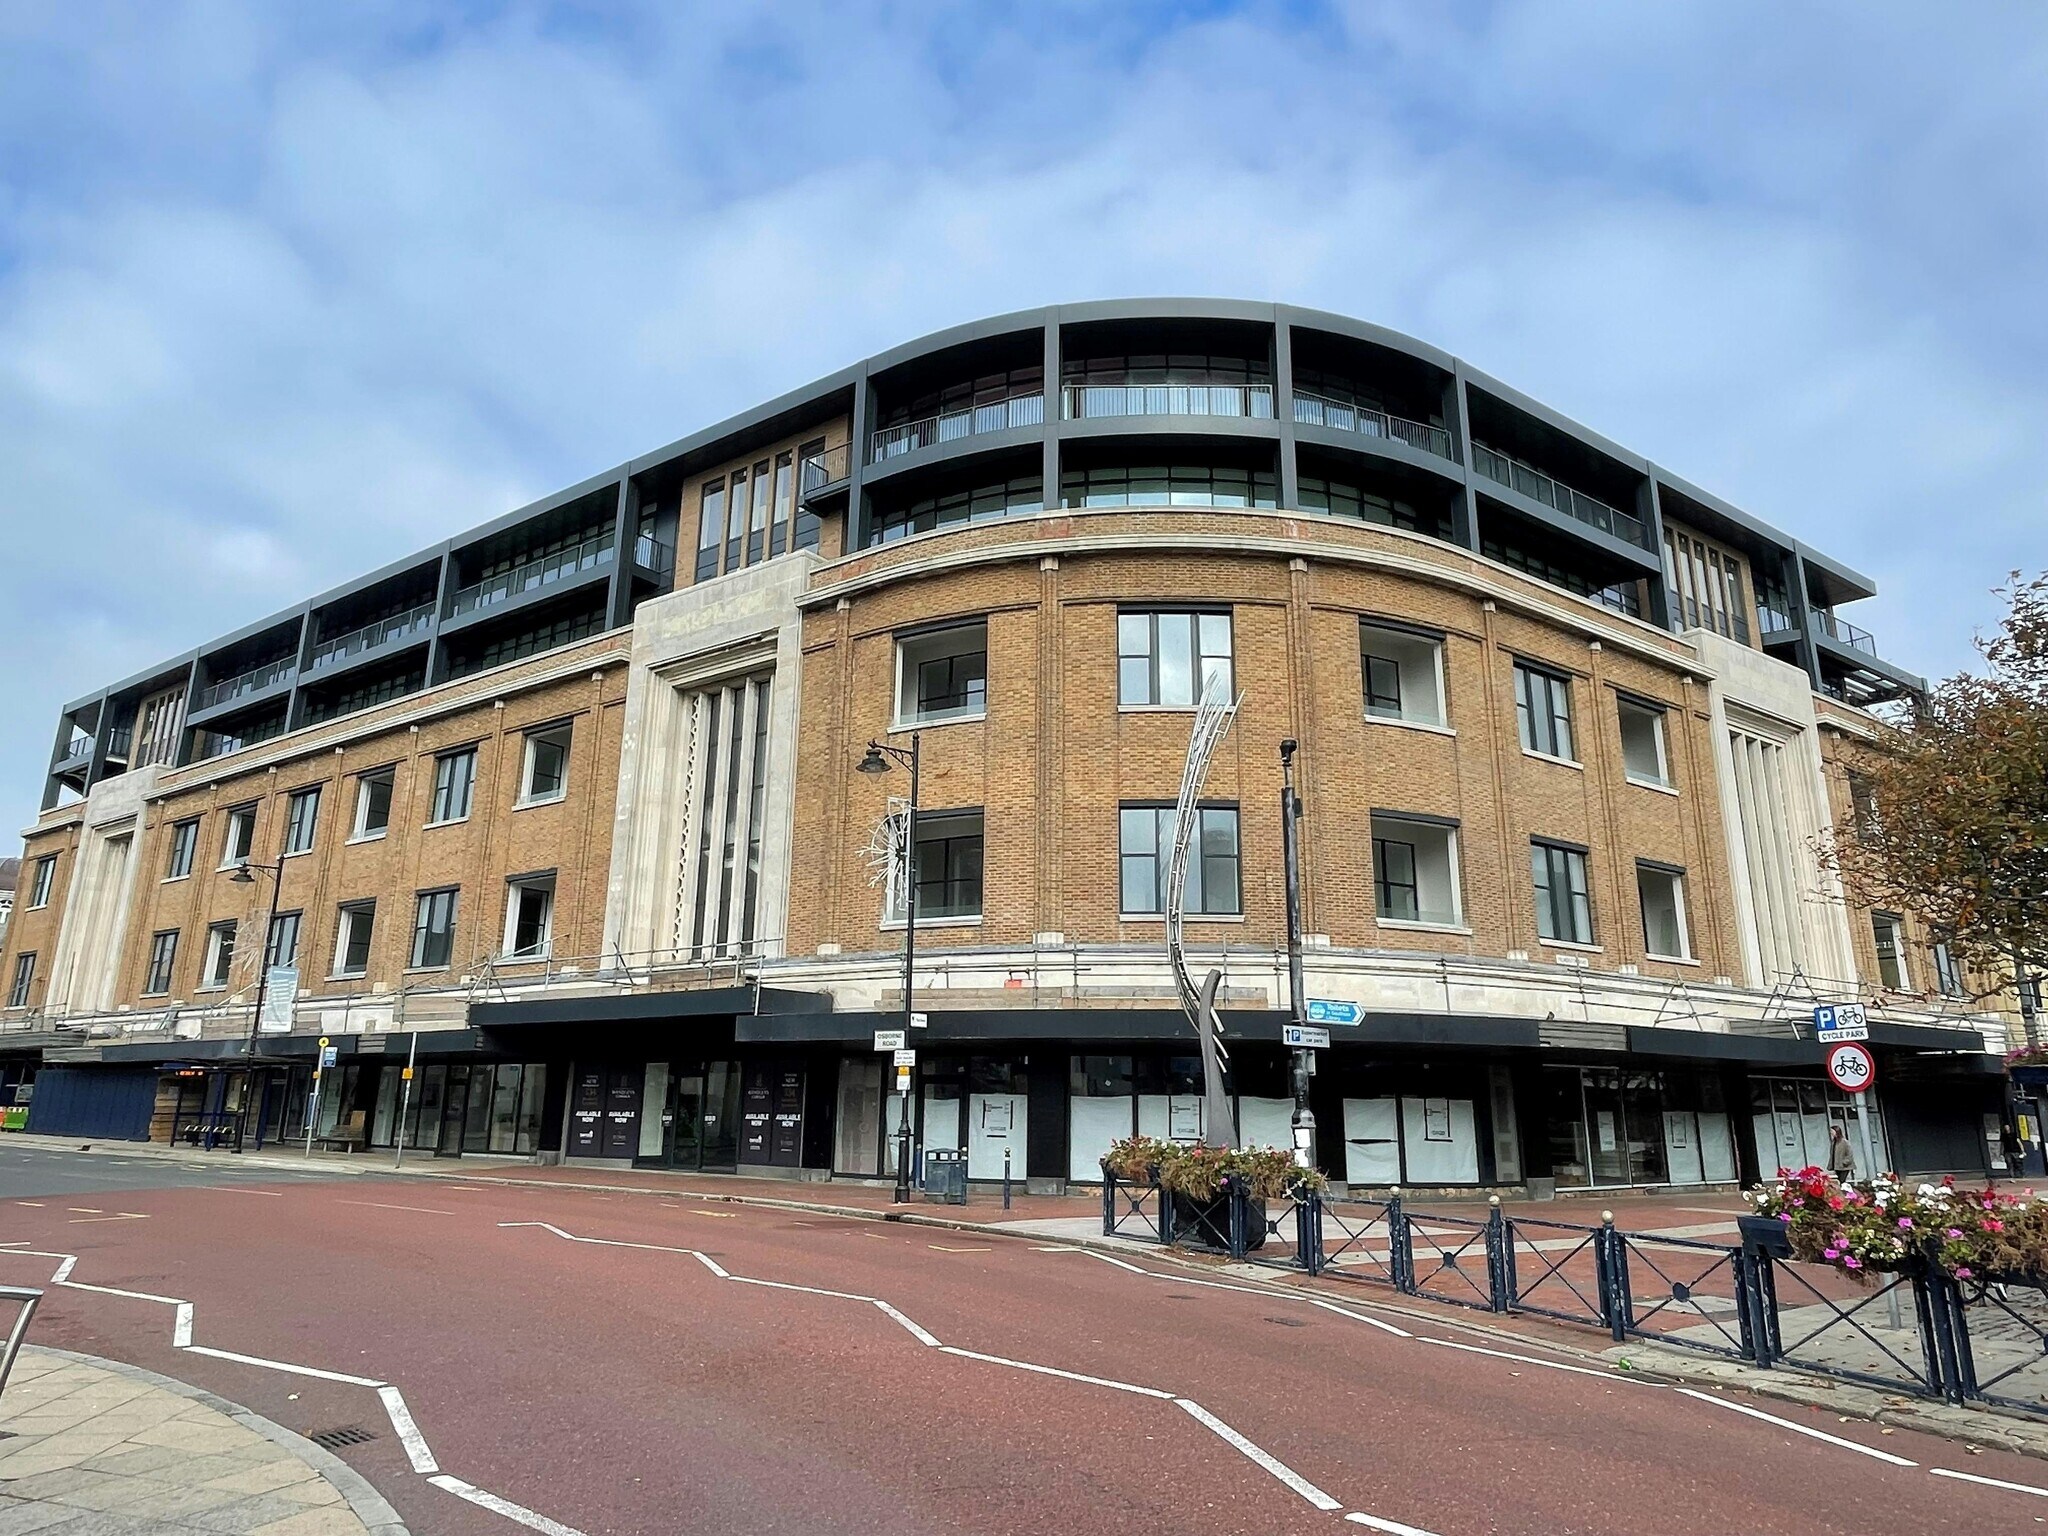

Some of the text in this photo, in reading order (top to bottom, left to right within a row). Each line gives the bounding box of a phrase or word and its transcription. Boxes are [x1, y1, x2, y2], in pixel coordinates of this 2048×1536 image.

[1326, 1004, 1350, 1012] Toilets
[1818, 1010, 1832, 1028] P
[1293, 1030, 1299, 1041] P
[1821, 1030, 1865, 1040] CYCLE PARK
